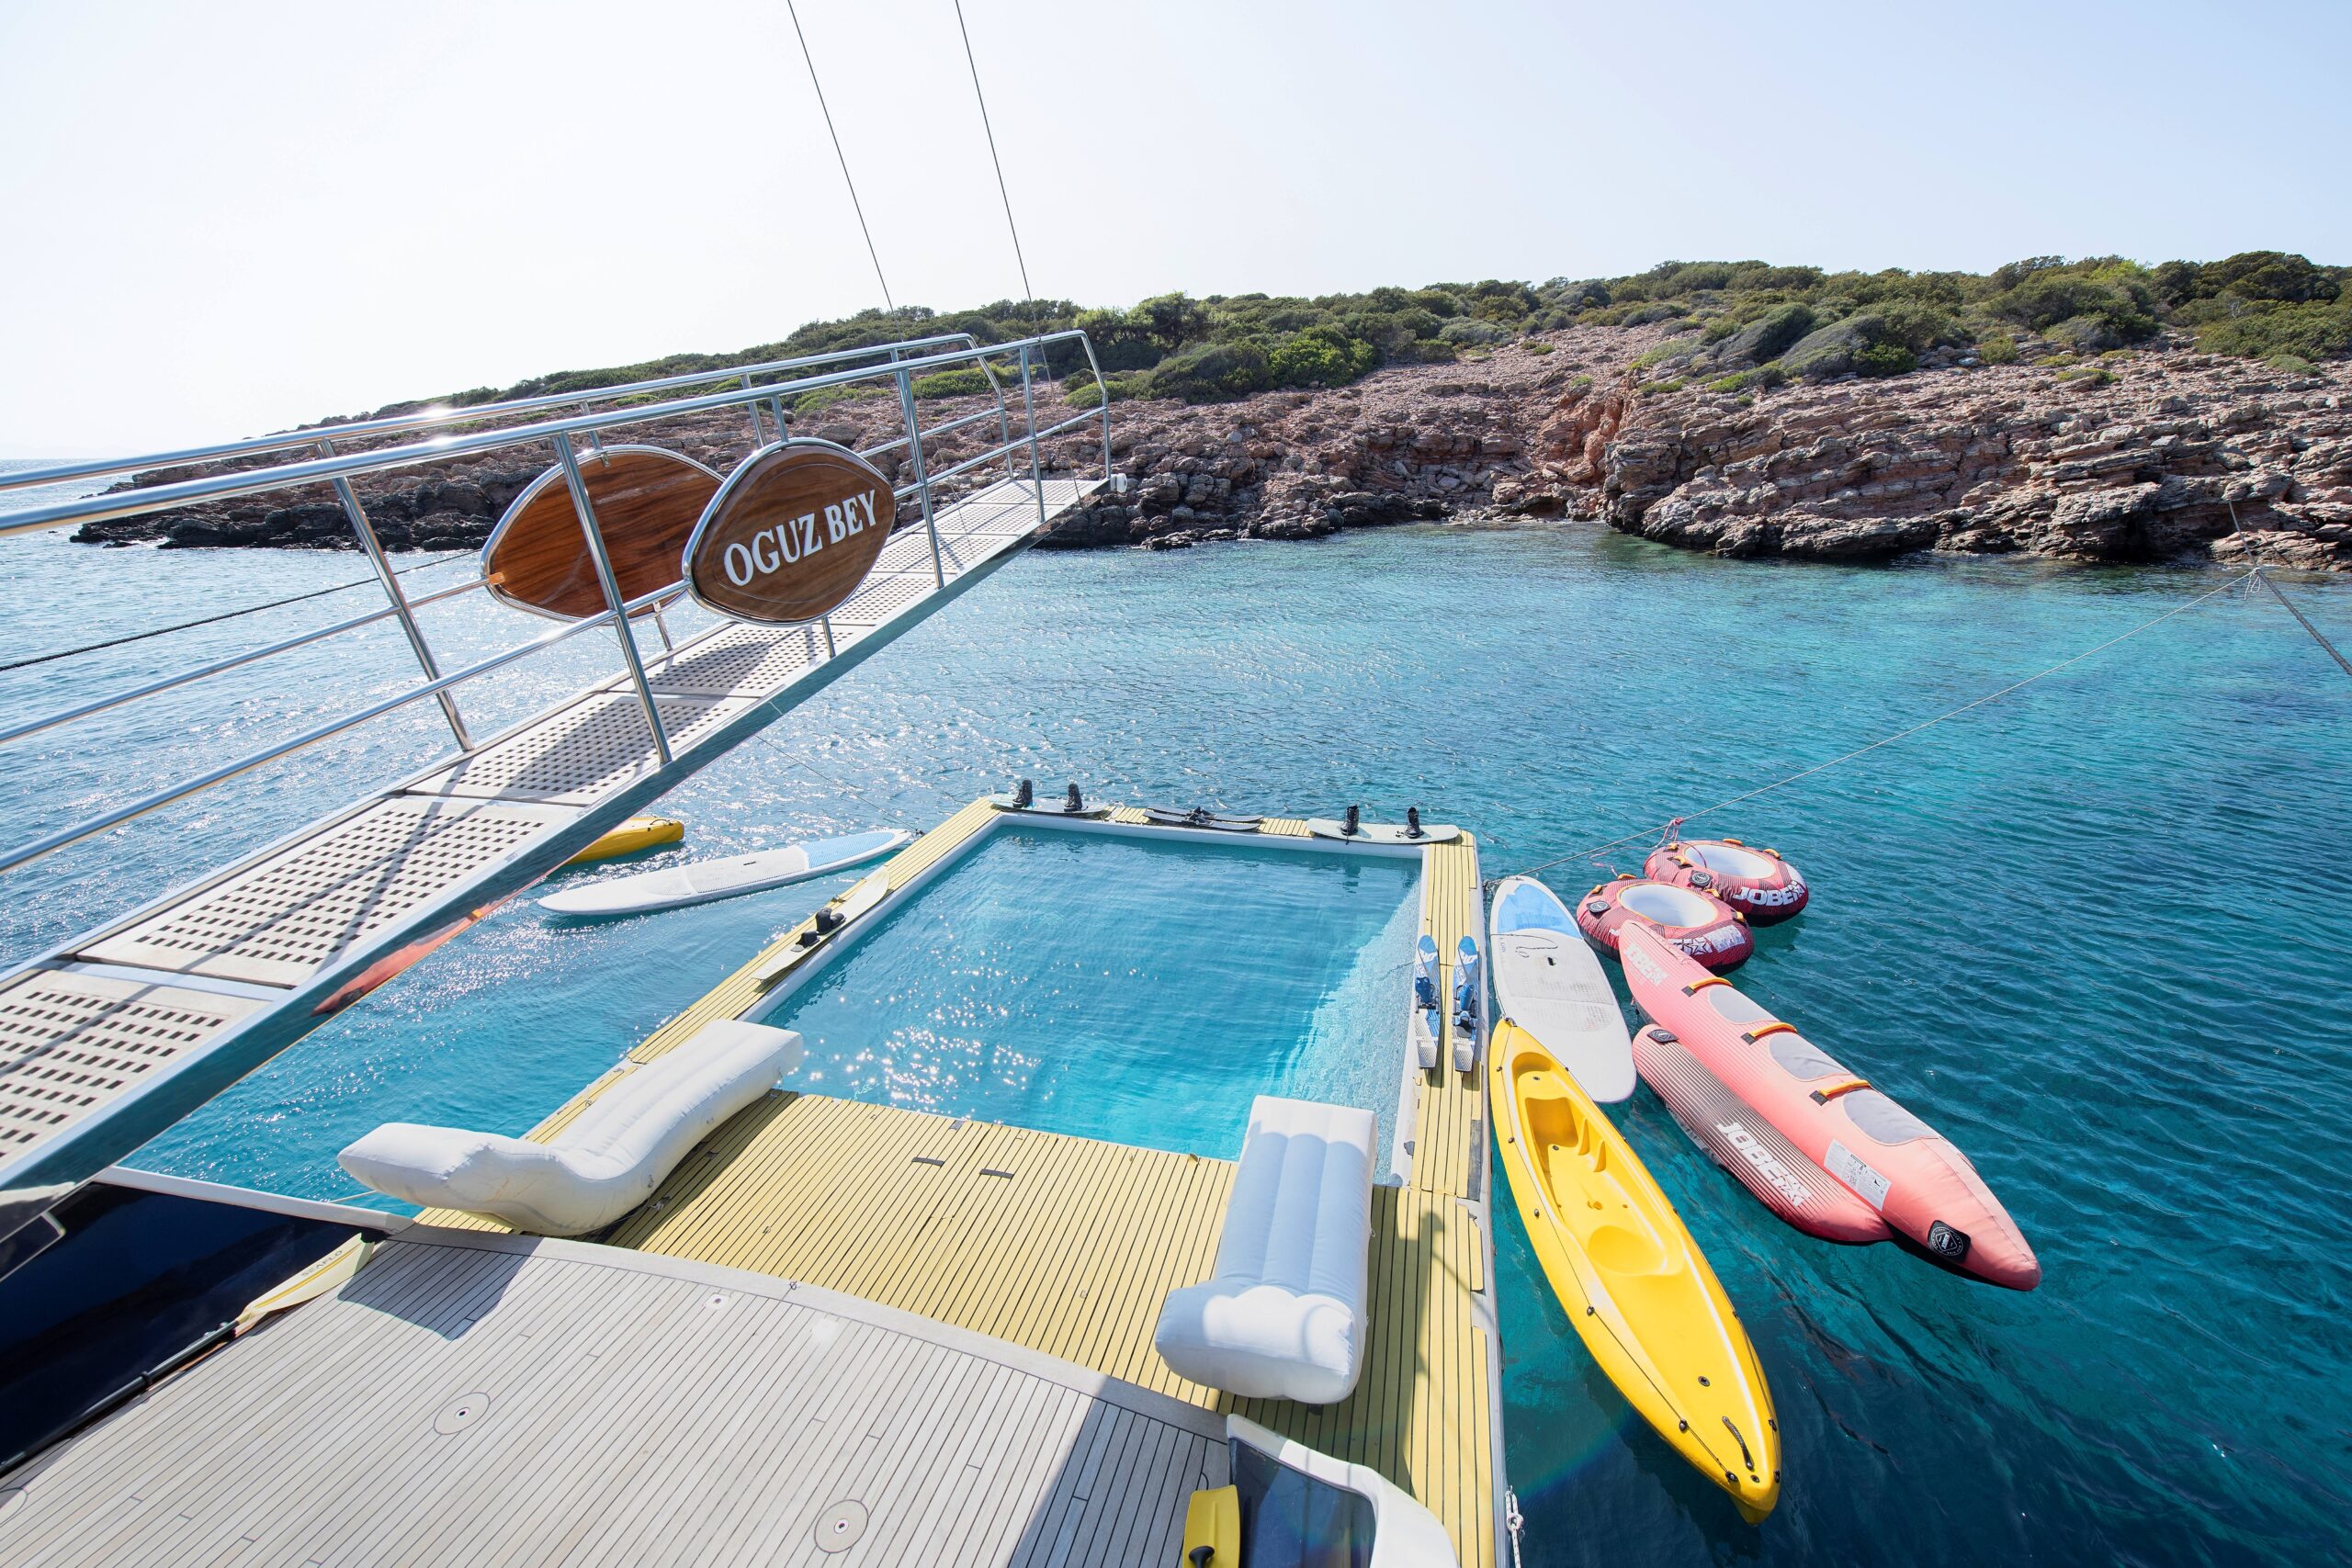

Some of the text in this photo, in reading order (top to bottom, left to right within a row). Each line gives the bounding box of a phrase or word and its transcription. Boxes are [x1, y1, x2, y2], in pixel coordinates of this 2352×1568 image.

[724, 490, 876, 586] OGUZ BEY
[1733, 885, 1796, 907] JOBE
[1716, 1122, 1796, 1188] JOBE
[301, 1250, 343, 1277] SEAFLO
